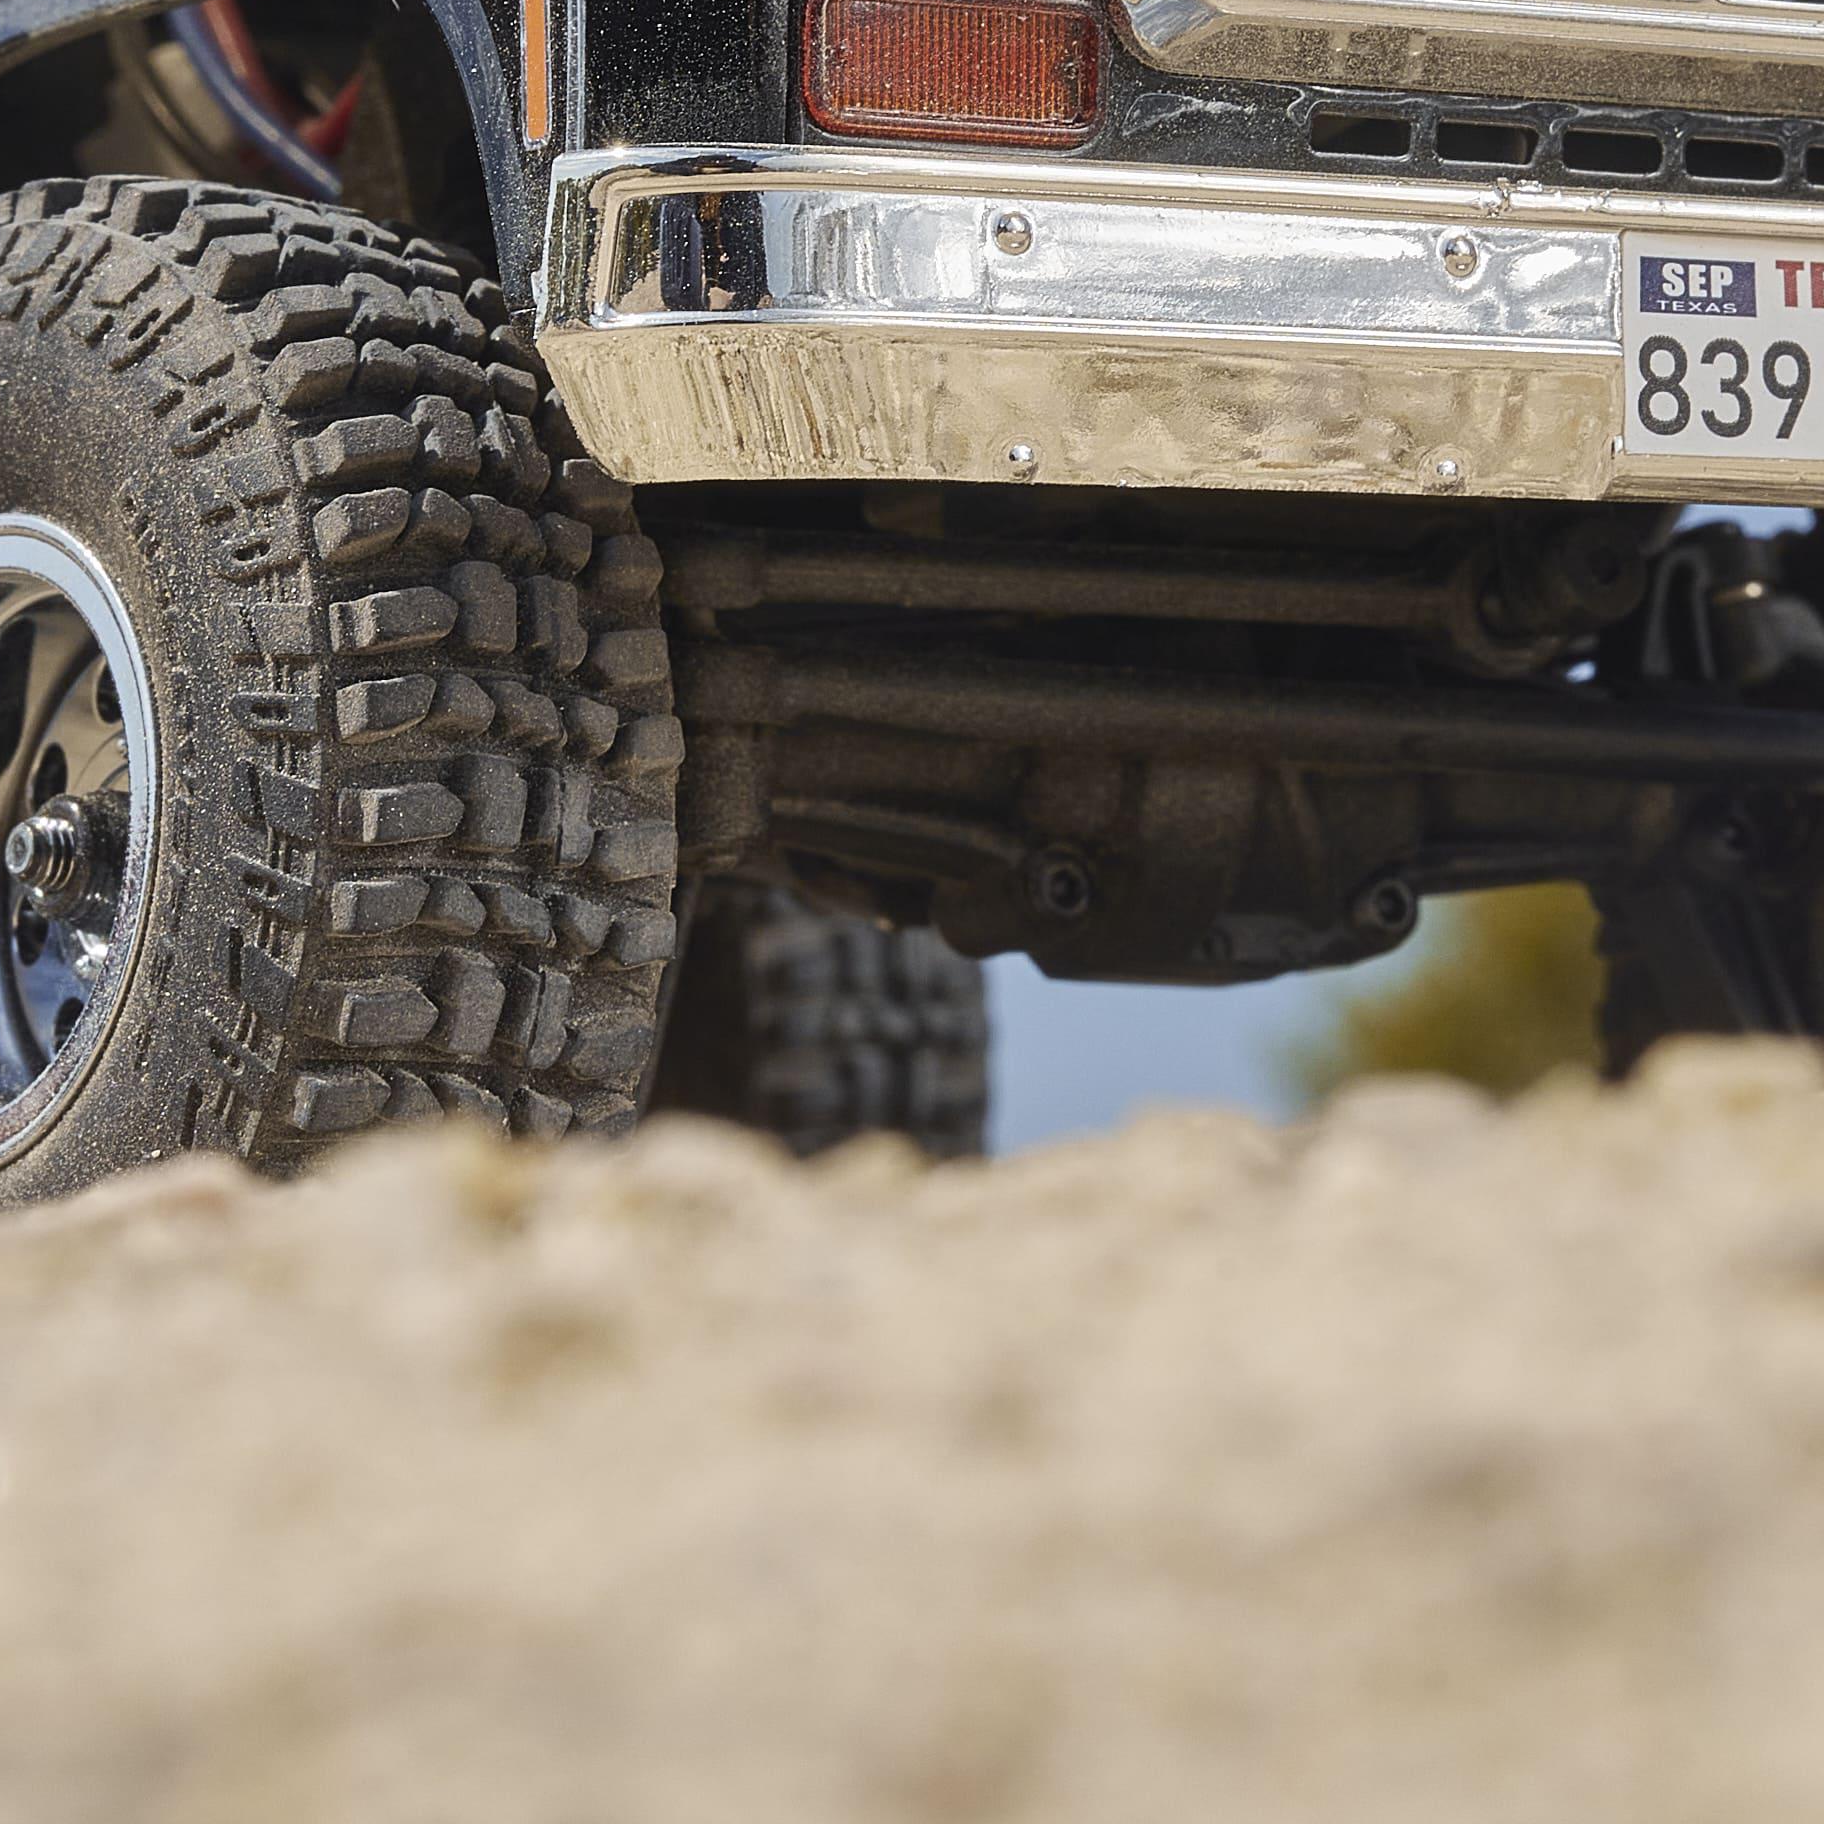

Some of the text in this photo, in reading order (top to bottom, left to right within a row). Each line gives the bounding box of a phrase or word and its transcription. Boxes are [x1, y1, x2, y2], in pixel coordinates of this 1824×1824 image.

[1661, 262, 1734, 298] SEP
[1656, 299, 1738, 314] TEXAS
[1638, 335, 1812, 440] 839
